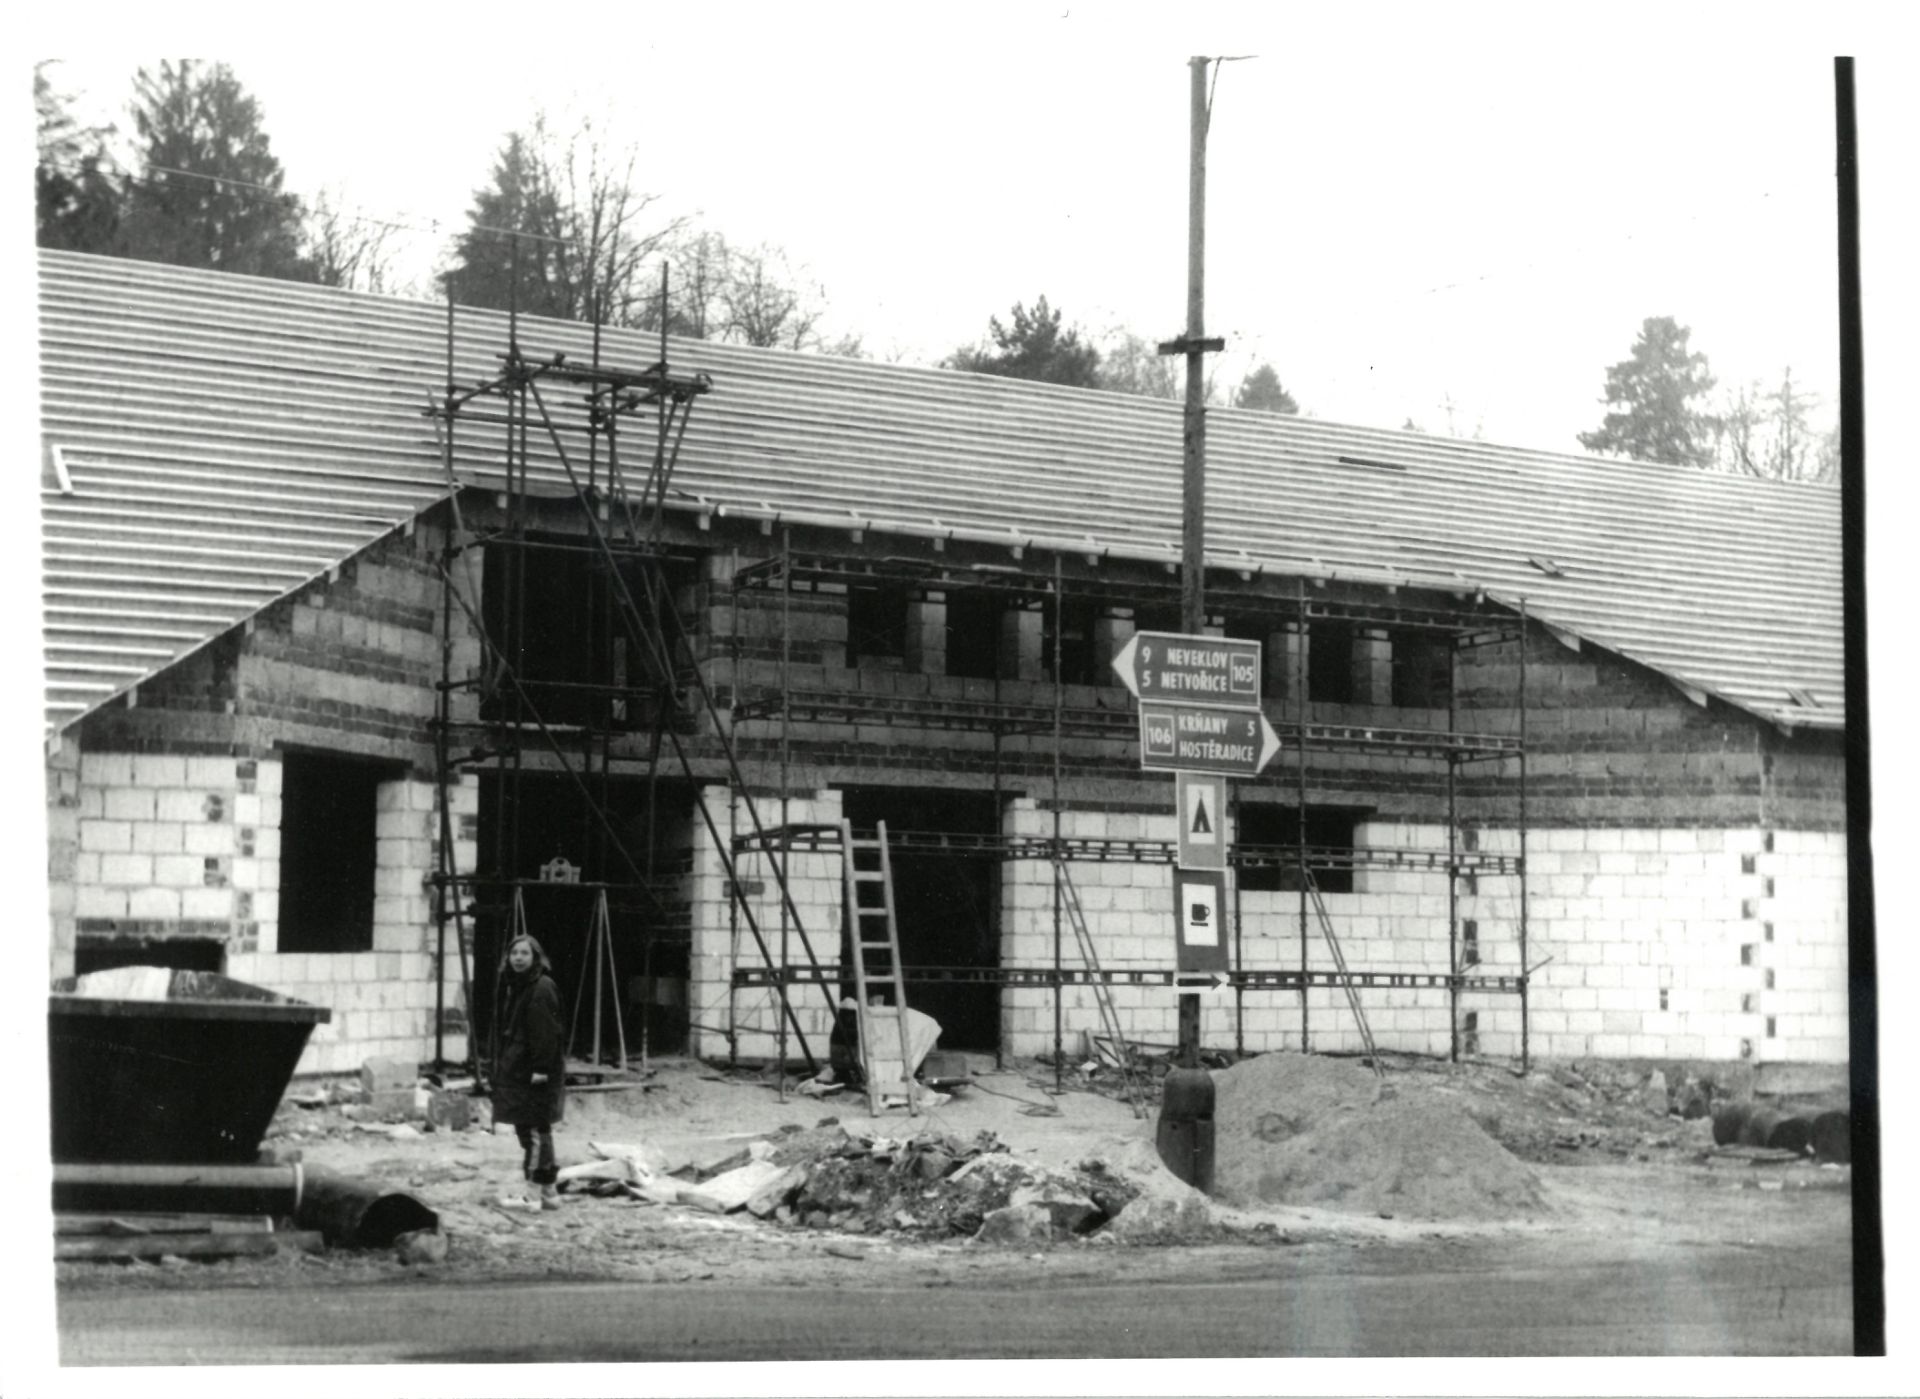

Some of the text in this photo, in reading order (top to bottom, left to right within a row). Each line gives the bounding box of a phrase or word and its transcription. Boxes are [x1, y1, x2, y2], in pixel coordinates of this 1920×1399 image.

[1142, 646, 1228, 668] 9 NEVEKLOV
[1142, 669, 1227, 692] 5 NETVOŘICE
[1233, 665, 1254, 683] 105
[1149, 727, 1172, 745] 106
[1178, 713, 1255, 737] KRŇANY 5
[1179, 739, 1253, 762] HOSTĚRADICE
